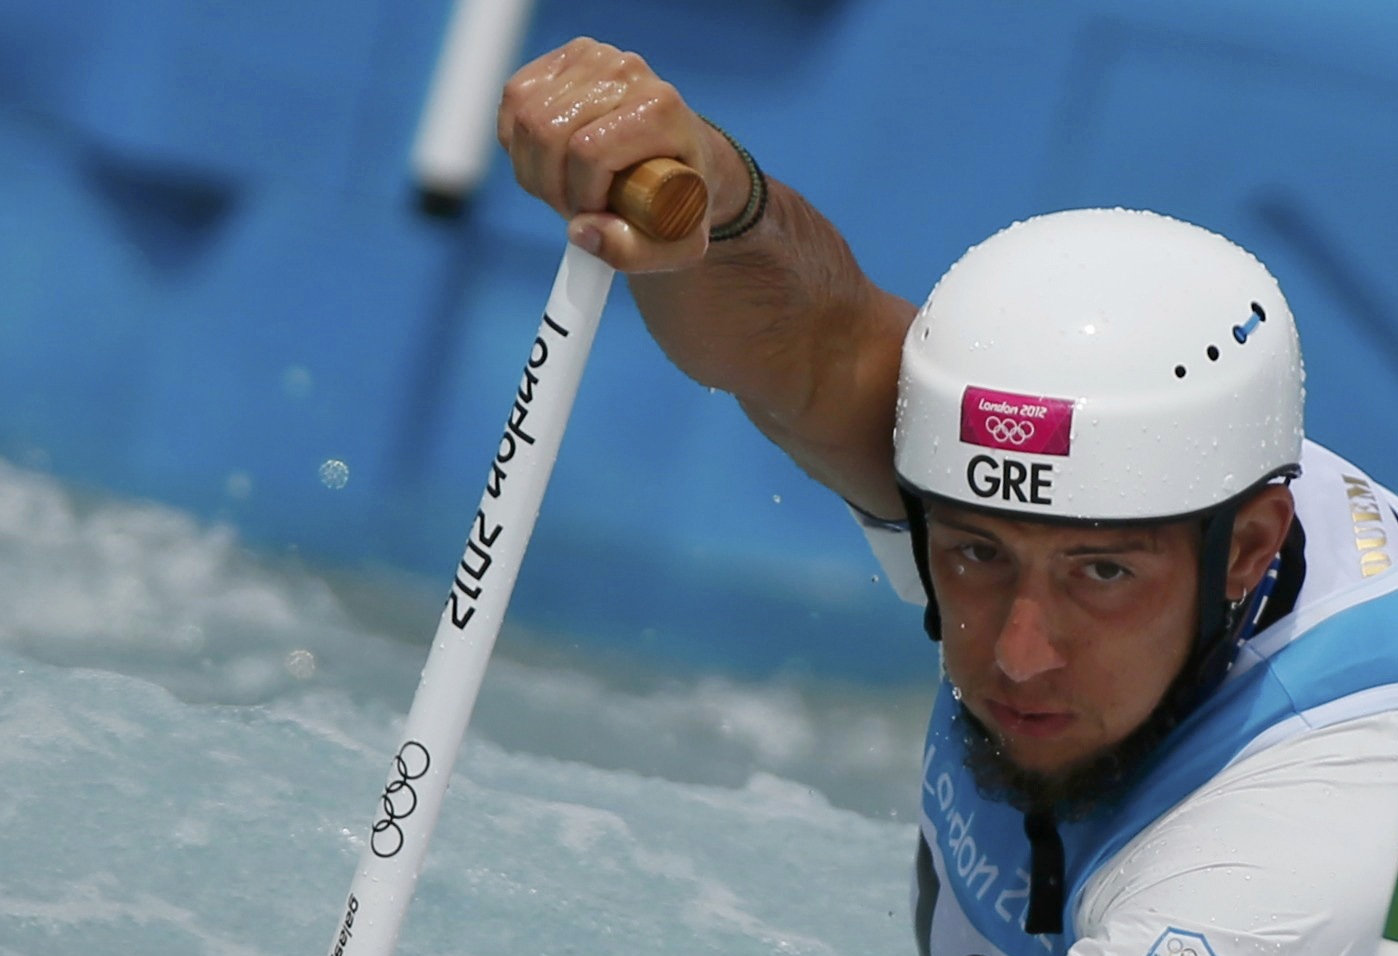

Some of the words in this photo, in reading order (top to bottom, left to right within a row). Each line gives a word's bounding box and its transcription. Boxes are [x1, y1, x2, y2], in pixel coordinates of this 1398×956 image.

[978, 397, 1019, 416] London
[1019, 403, 1048, 419] 2012
[966, 454, 1053, 506] GRE
[446, 508, 504, 630] 2012
